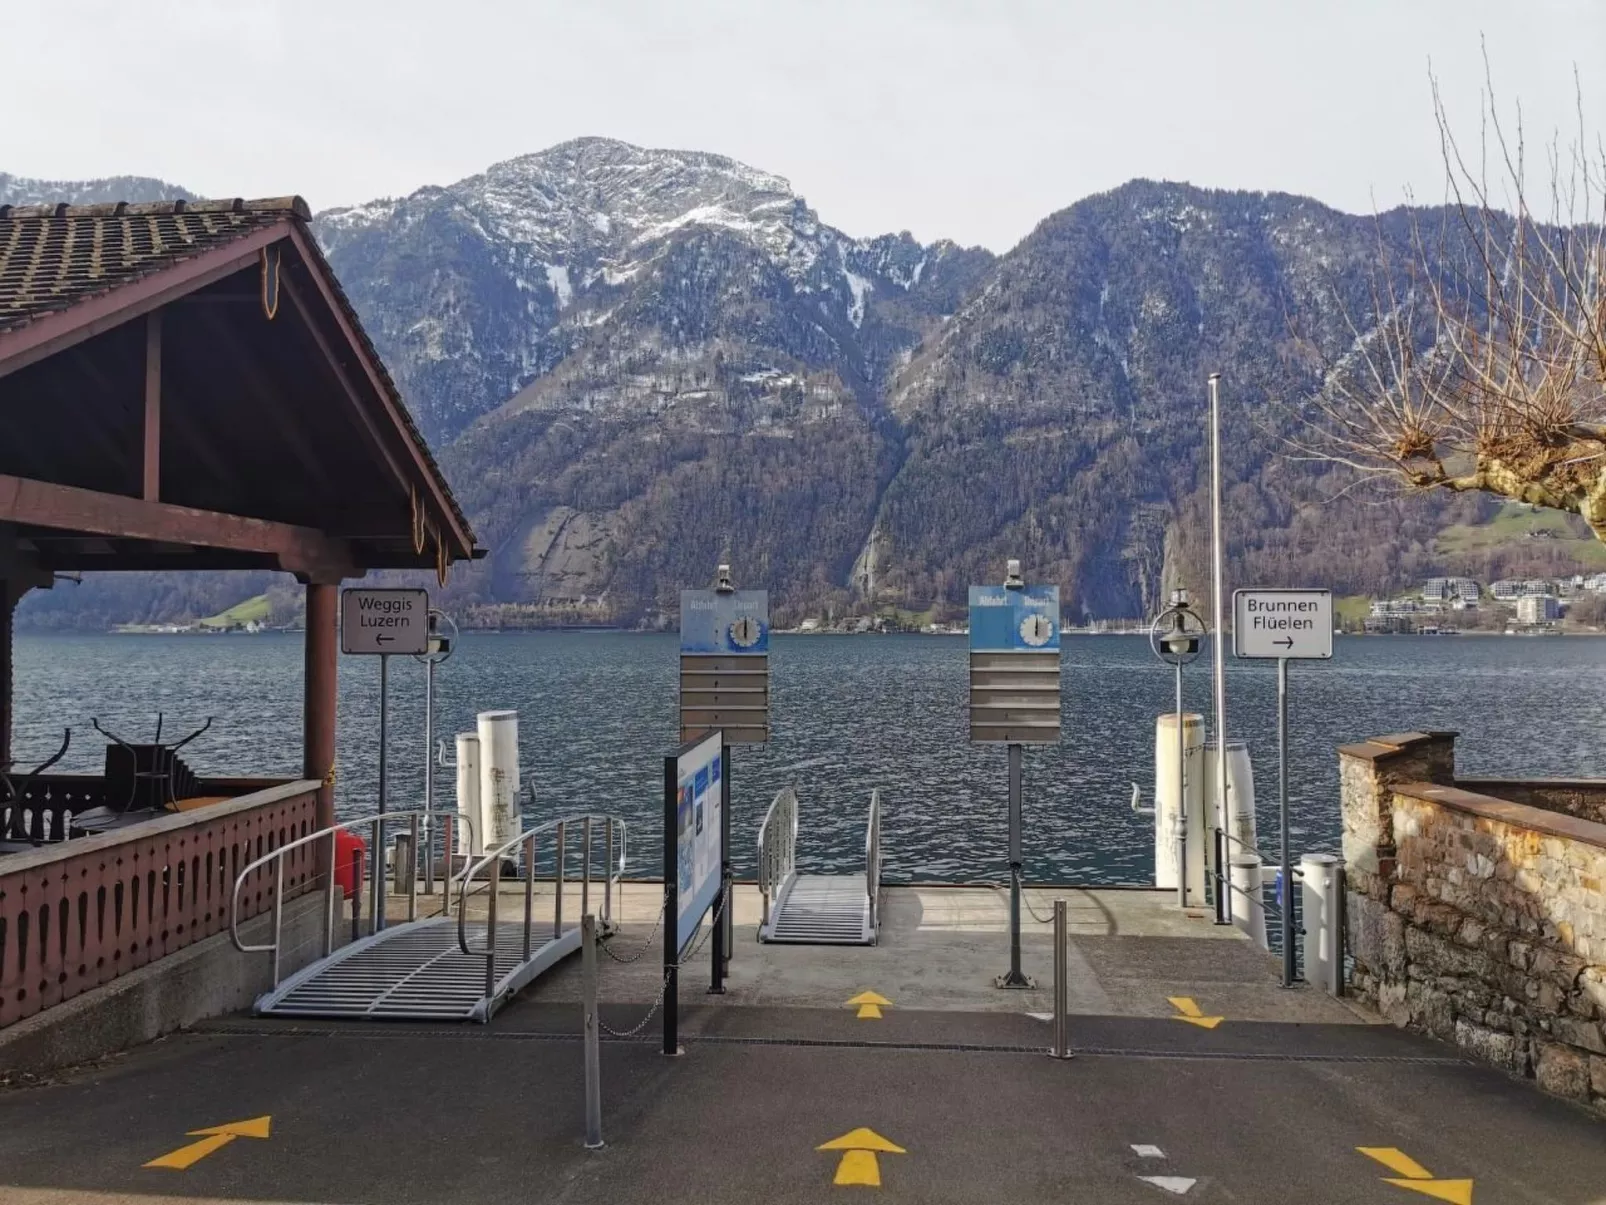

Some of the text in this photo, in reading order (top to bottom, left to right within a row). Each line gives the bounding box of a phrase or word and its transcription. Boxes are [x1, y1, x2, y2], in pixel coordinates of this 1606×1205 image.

[358, 597, 412, 613] Weggis
[1247, 599, 1318, 612] Brunnen
[360, 615, 410, 627] Luzern
[1253, 616, 1313, 629] Flüelen
